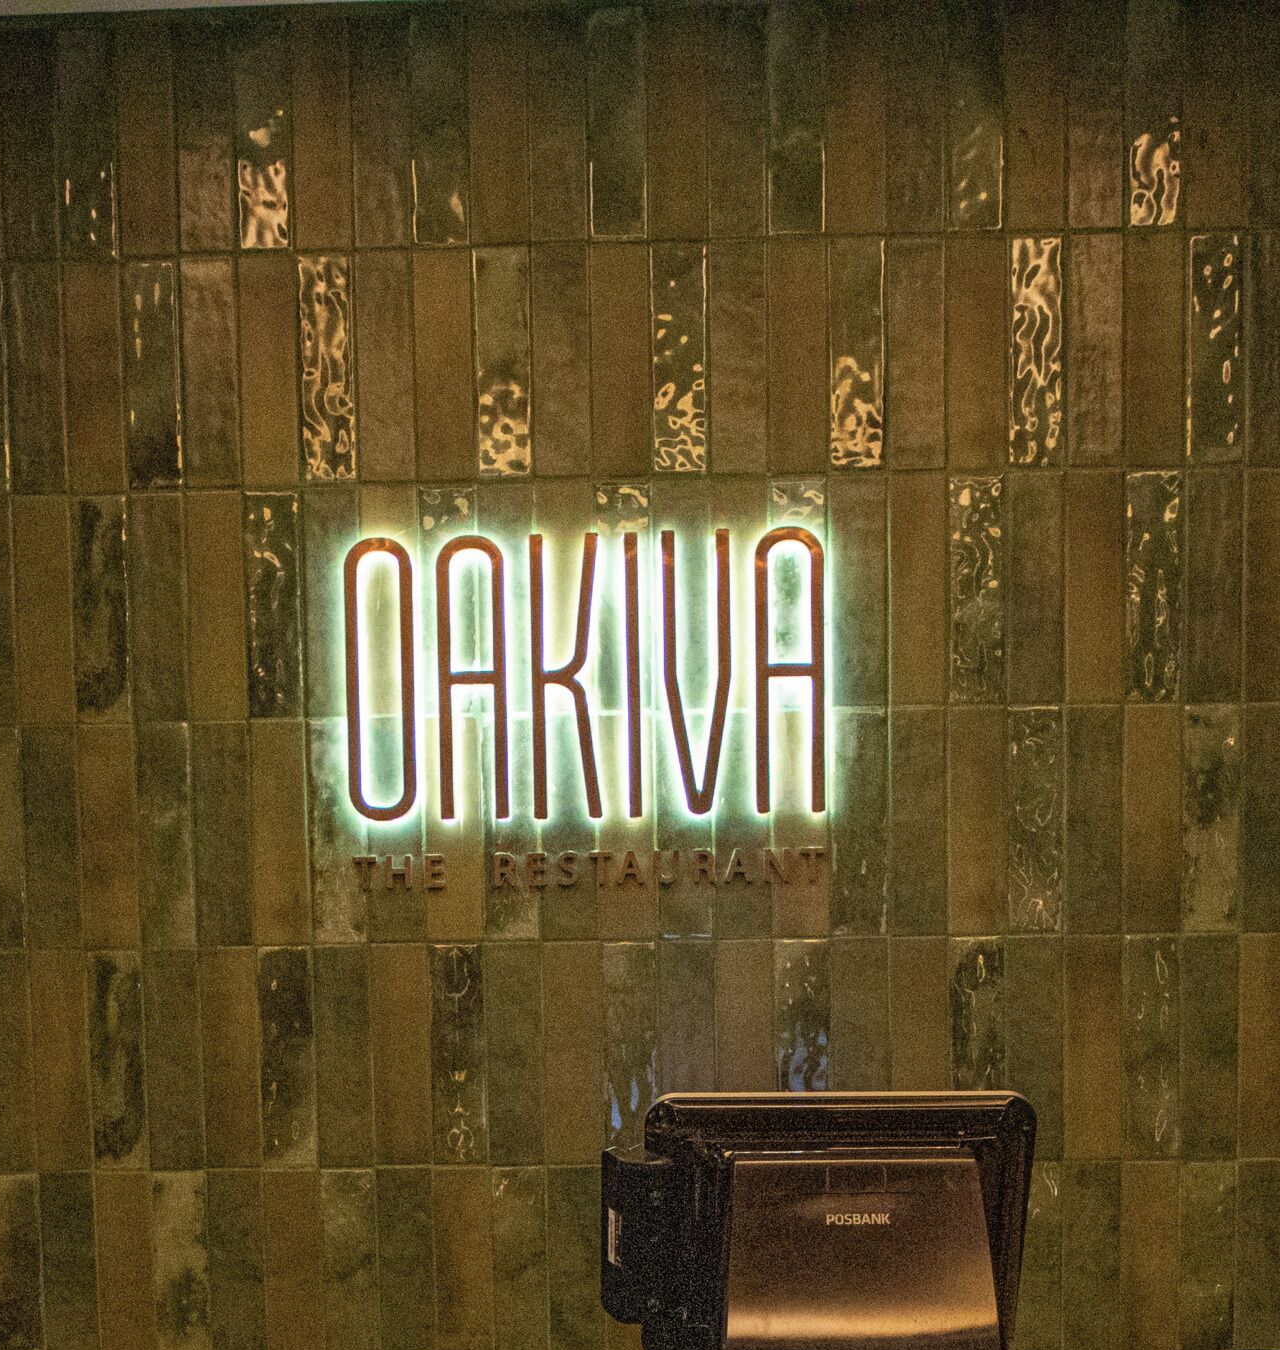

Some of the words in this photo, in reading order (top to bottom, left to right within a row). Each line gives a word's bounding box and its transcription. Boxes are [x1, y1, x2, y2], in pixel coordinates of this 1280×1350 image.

[343, 526, 826, 822] OAKIVA
[352, 852, 447, 893] THE
[492, 845, 826, 890] RESTAURANT
[826, 1213, 891, 1226] POSBANK
